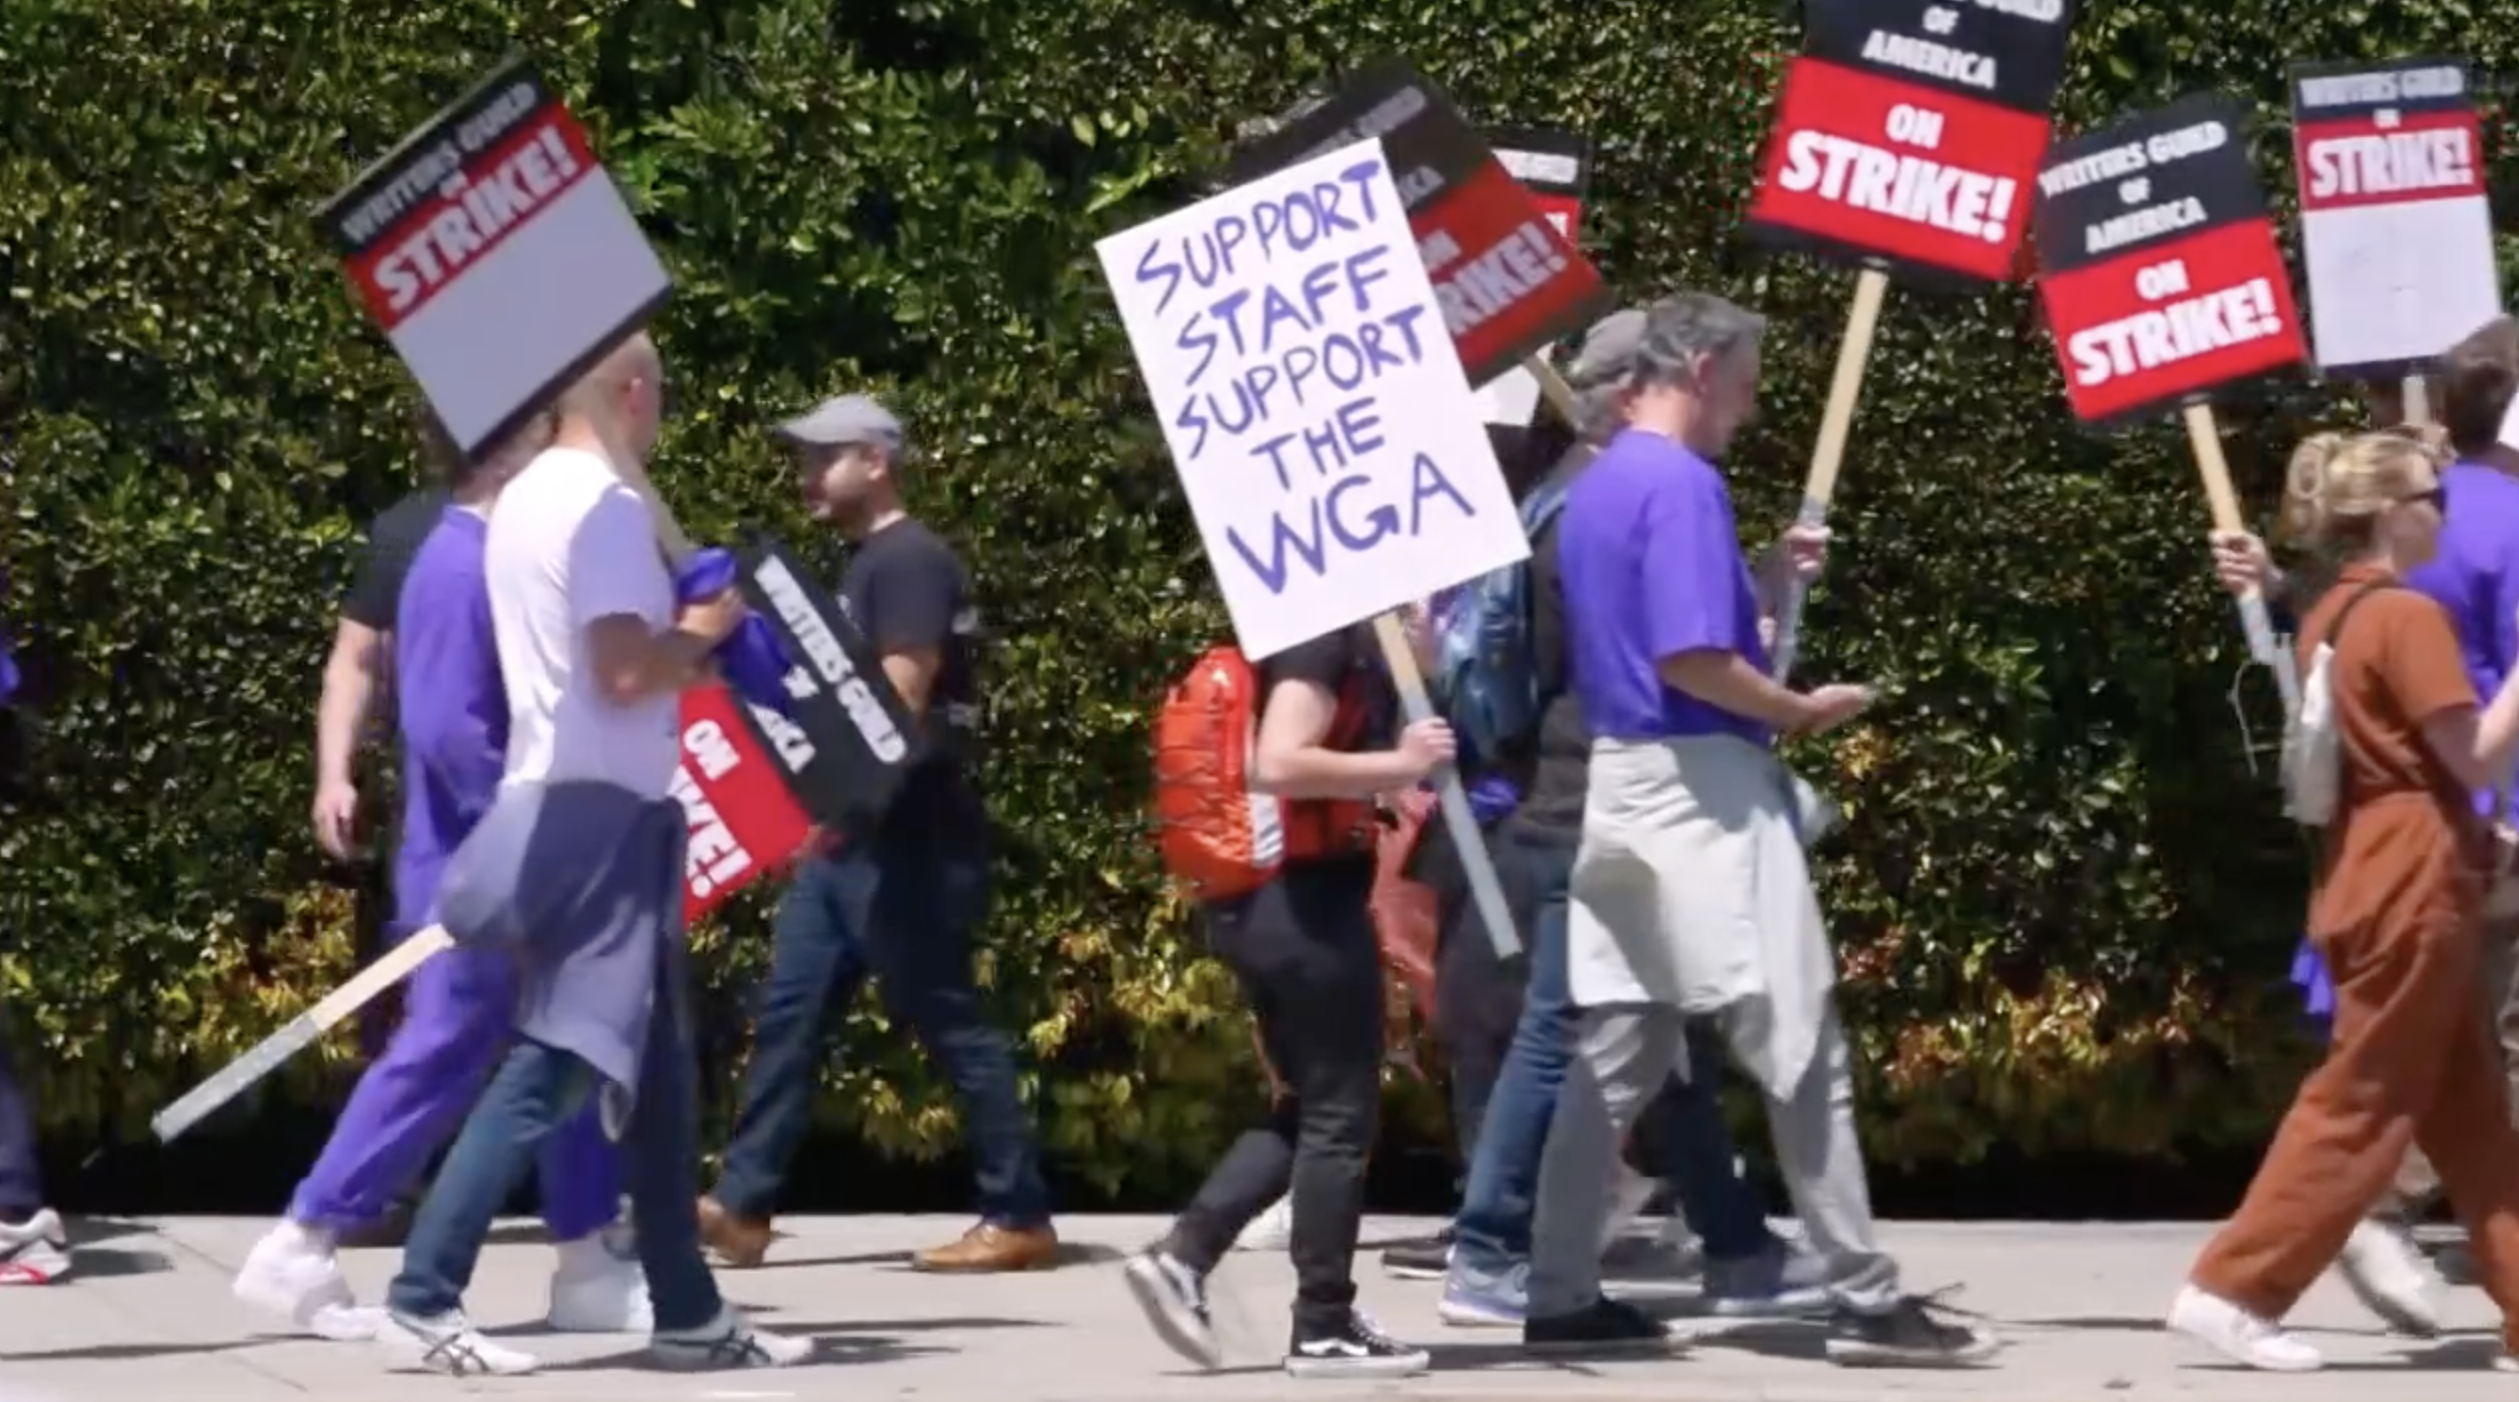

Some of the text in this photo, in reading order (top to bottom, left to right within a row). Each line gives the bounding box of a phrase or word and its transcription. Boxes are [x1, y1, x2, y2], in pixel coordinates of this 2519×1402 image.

[1862, 30, 1995, 89] AMERICA
[1924, 6, 1959, 34] OF
[339, 81, 538, 244] WRITERS GUILD
[1885, 103, 1944, 149] ON
[2037, 120, 2228, 198] WRITERS GUILD
[2307, 126, 2475, 198] STRIKE!
[372, 124, 579, 311] STRIKE!
[1135, 159, 1381, 318] SUPPORT
[1778, 129, 2017, 243] STRIKE!
[2085, 196, 2208, 254] AMERICA
[1176, 244, 1391, 388] STAFF
[1433, 221, 1568, 336] RIKE!
[2067, 277, 2283, 386] STRIKE!
[2135, 258, 2190, 301] ON
[1175, 303, 1426, 461] SUPPORT
[1249, 395, 1385, 492] THE
[1226, 451, 1477, 595] WGA
[754, 553, 854, 683] WRITERS
[837, 677, 907, 764] GUILD
[682, 718, 742, 782] ON
